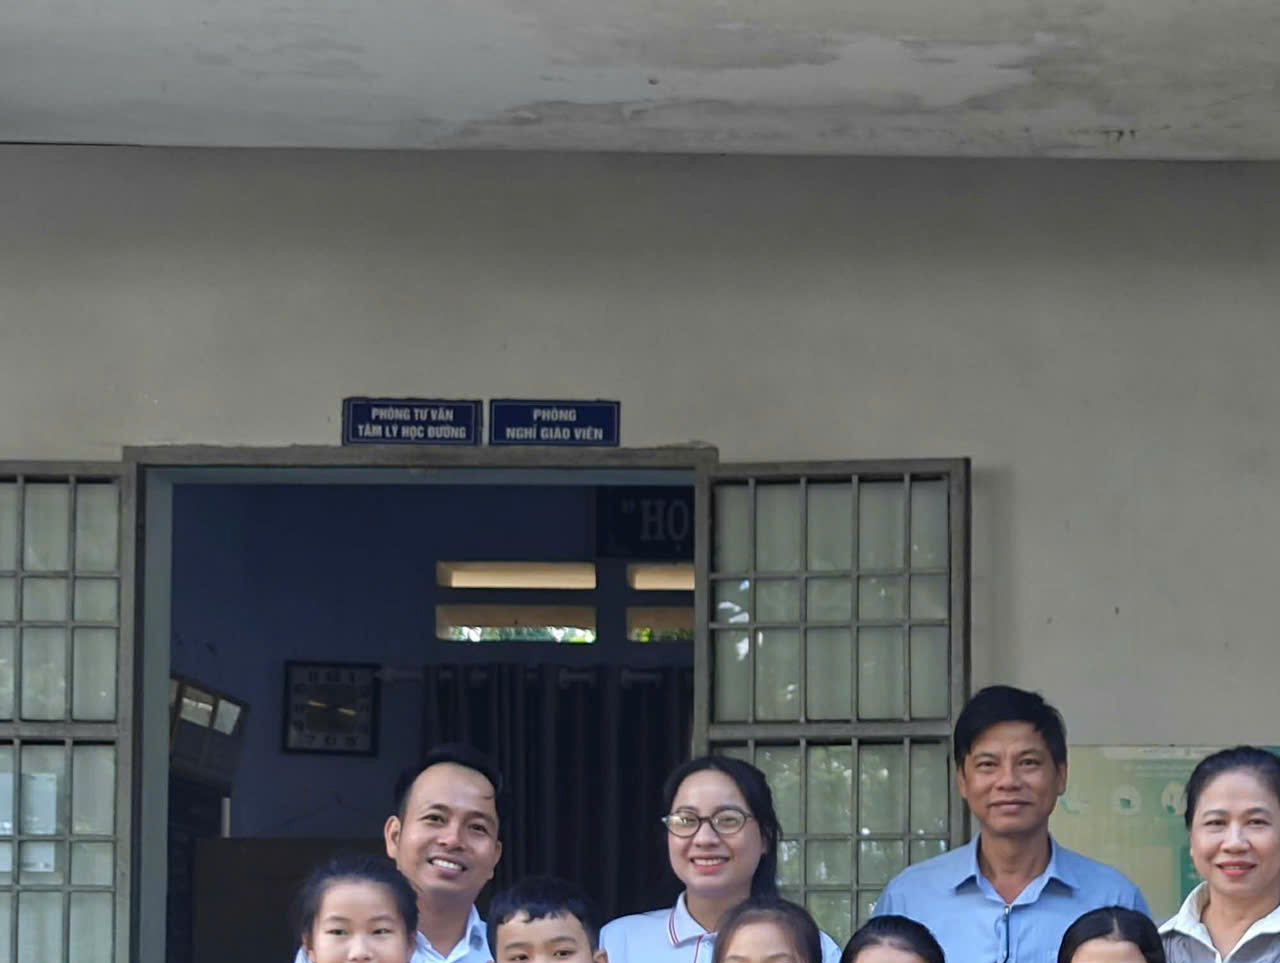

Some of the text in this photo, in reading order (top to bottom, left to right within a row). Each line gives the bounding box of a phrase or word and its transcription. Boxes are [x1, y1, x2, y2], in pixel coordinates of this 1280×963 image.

[371, 406, 411, 421] PHÒNG
[413, 407, 429, 421] TƯ
[532, 407, 577, 422] PHÒNG
[357, 423, 383, 437] TÂM
[401, 425, 425, 440] HỌC
[573, 425, 604, 441] VIÊN
